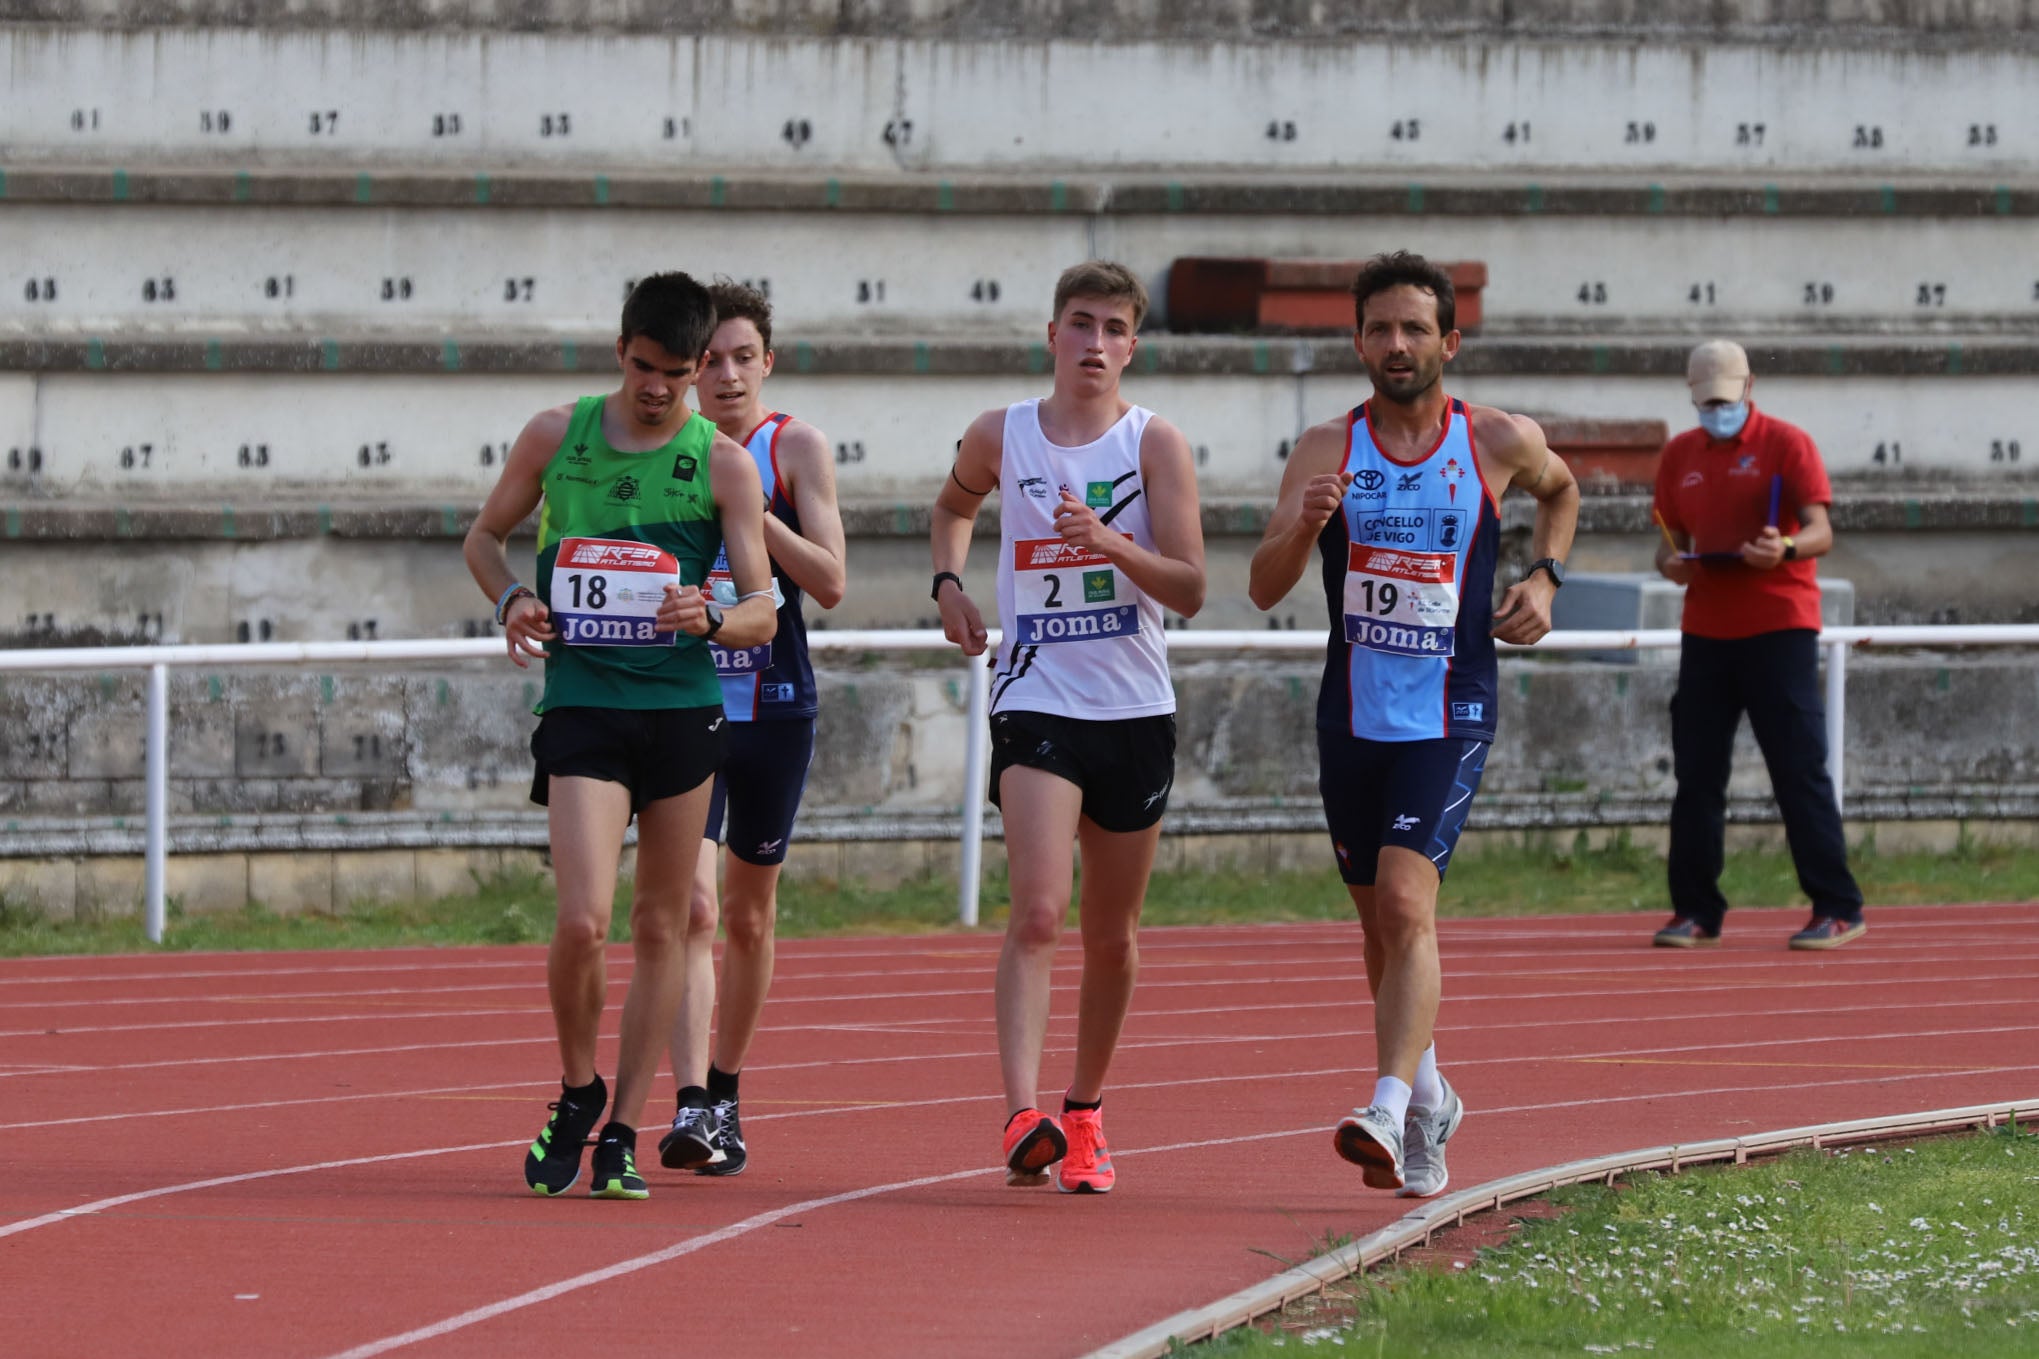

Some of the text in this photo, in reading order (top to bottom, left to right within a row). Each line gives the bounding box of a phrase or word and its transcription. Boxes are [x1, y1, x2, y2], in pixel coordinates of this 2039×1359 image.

[1874, 442, 1901, 465] 41
[1352, 491, 1387, 500] NIPOCAR
[1384, 531, 1415, 544] VIGO
[604, 545, 661, 560] RFEA
[568, 574, 607, 610] 18
[1043, 574, 1063, 608] 2
[1361, 580, 1398, 616] 19
